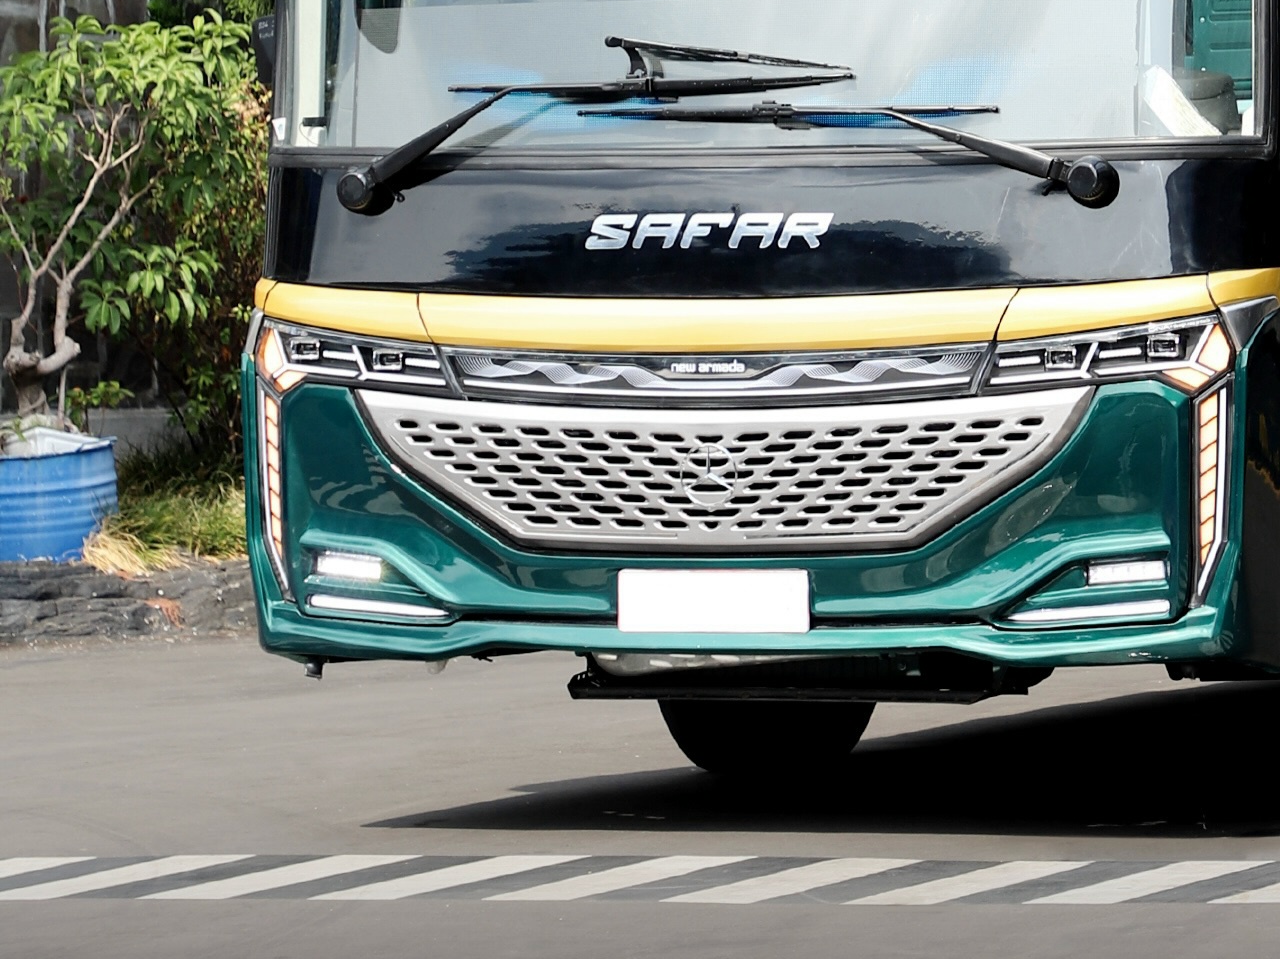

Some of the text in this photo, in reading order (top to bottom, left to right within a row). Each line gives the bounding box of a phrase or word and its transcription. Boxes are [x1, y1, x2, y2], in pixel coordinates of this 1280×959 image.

[584, 211, 835, 251] SAFAR
[670, 358, 746, 374] new armada
